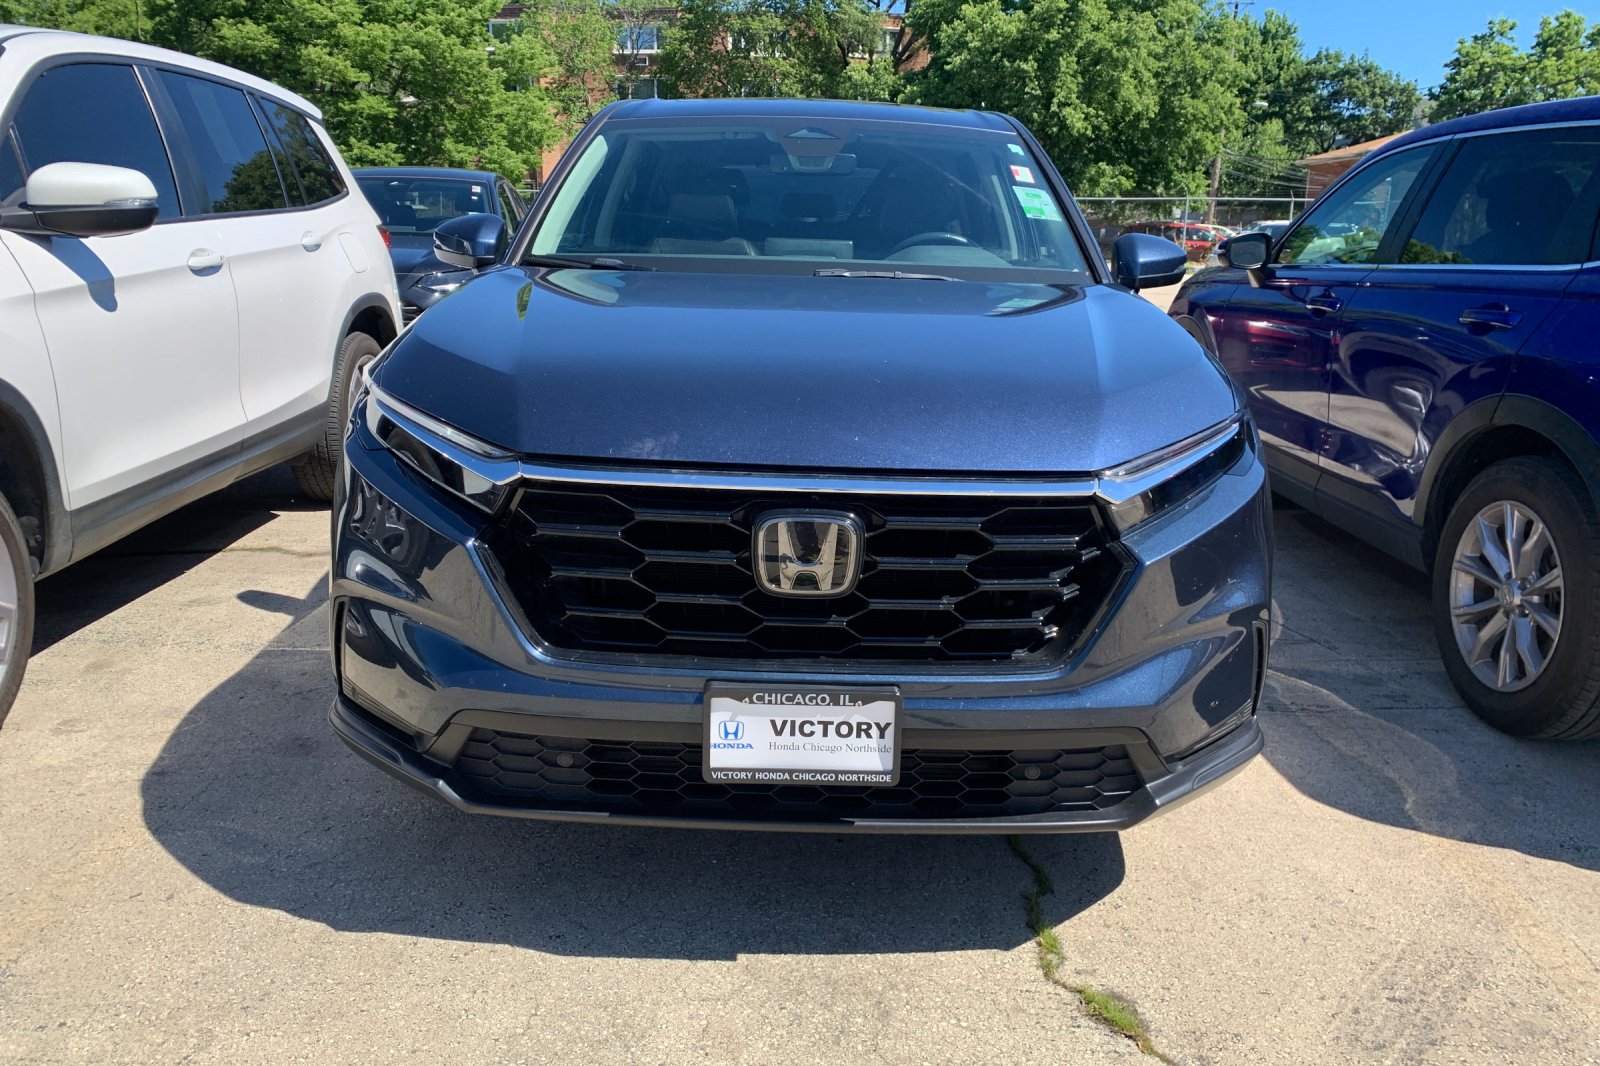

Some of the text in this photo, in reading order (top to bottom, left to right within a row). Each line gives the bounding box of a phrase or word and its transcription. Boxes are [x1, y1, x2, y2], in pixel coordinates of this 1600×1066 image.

[752, 692, 833, 707] CHICAGO,
[769, 719, 892, 740] VICTORY
[769, 741, 892, 754] Honda Chicago Northside
[711, 771, 892, 782] VICTORY HONDA CHICAGO NORTHSIDE
